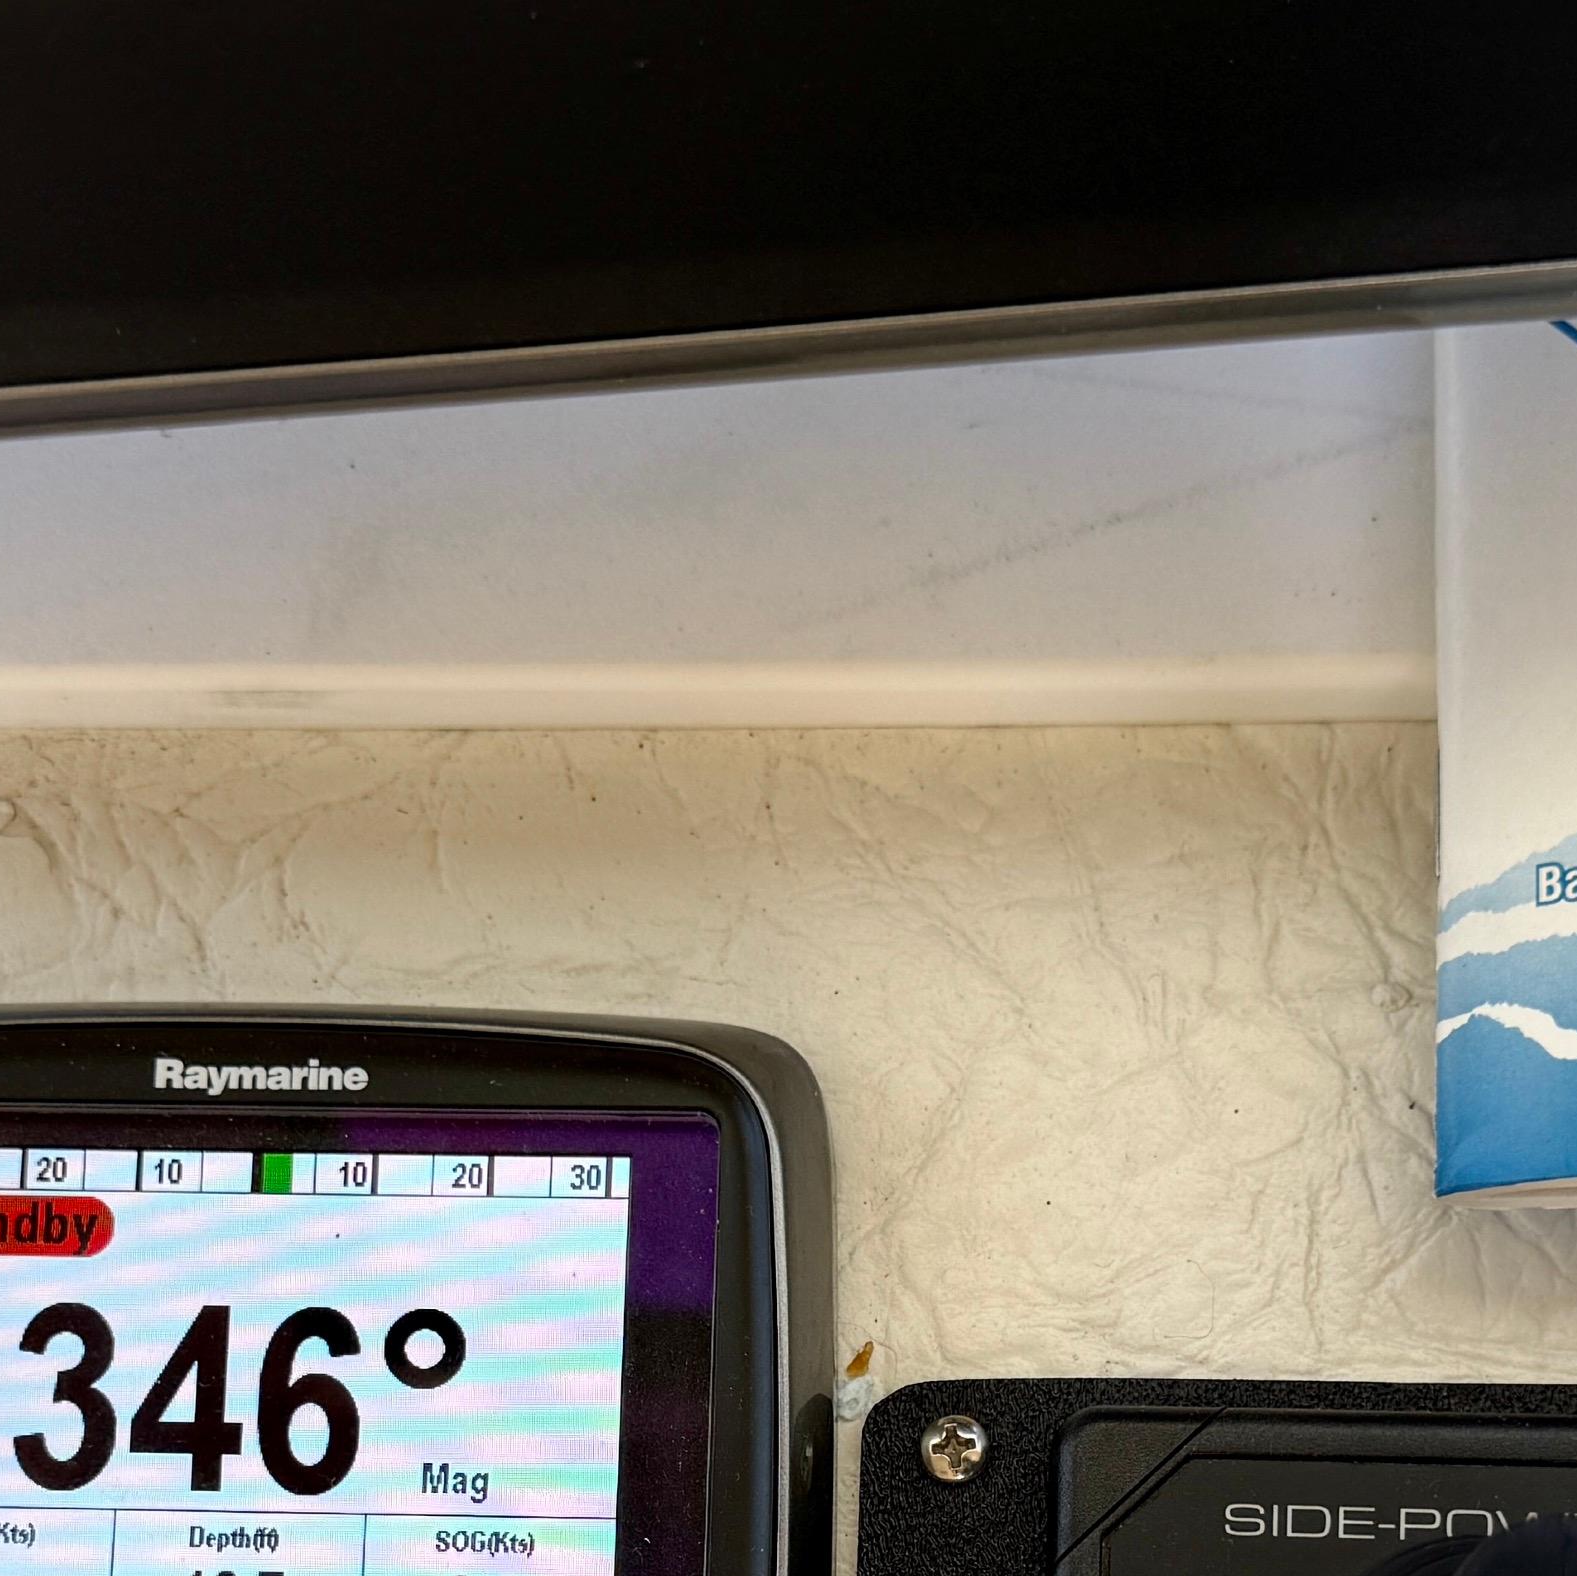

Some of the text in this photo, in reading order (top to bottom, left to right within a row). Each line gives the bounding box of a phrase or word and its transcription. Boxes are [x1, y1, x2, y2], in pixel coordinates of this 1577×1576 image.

[153, 1058, 370, 1094] Raymarine
[35, 1155, 69, 1184] 20
[152, 1156, 184, 1185] 10
[337, 1160, 368, 1189] 10
[451, 1161, 484, 1190] 20
[568, 1162, 603, 1192] 30
[12, 1302, 467, 1496] 346°
[421, 1463, 490, 1503] Mag
